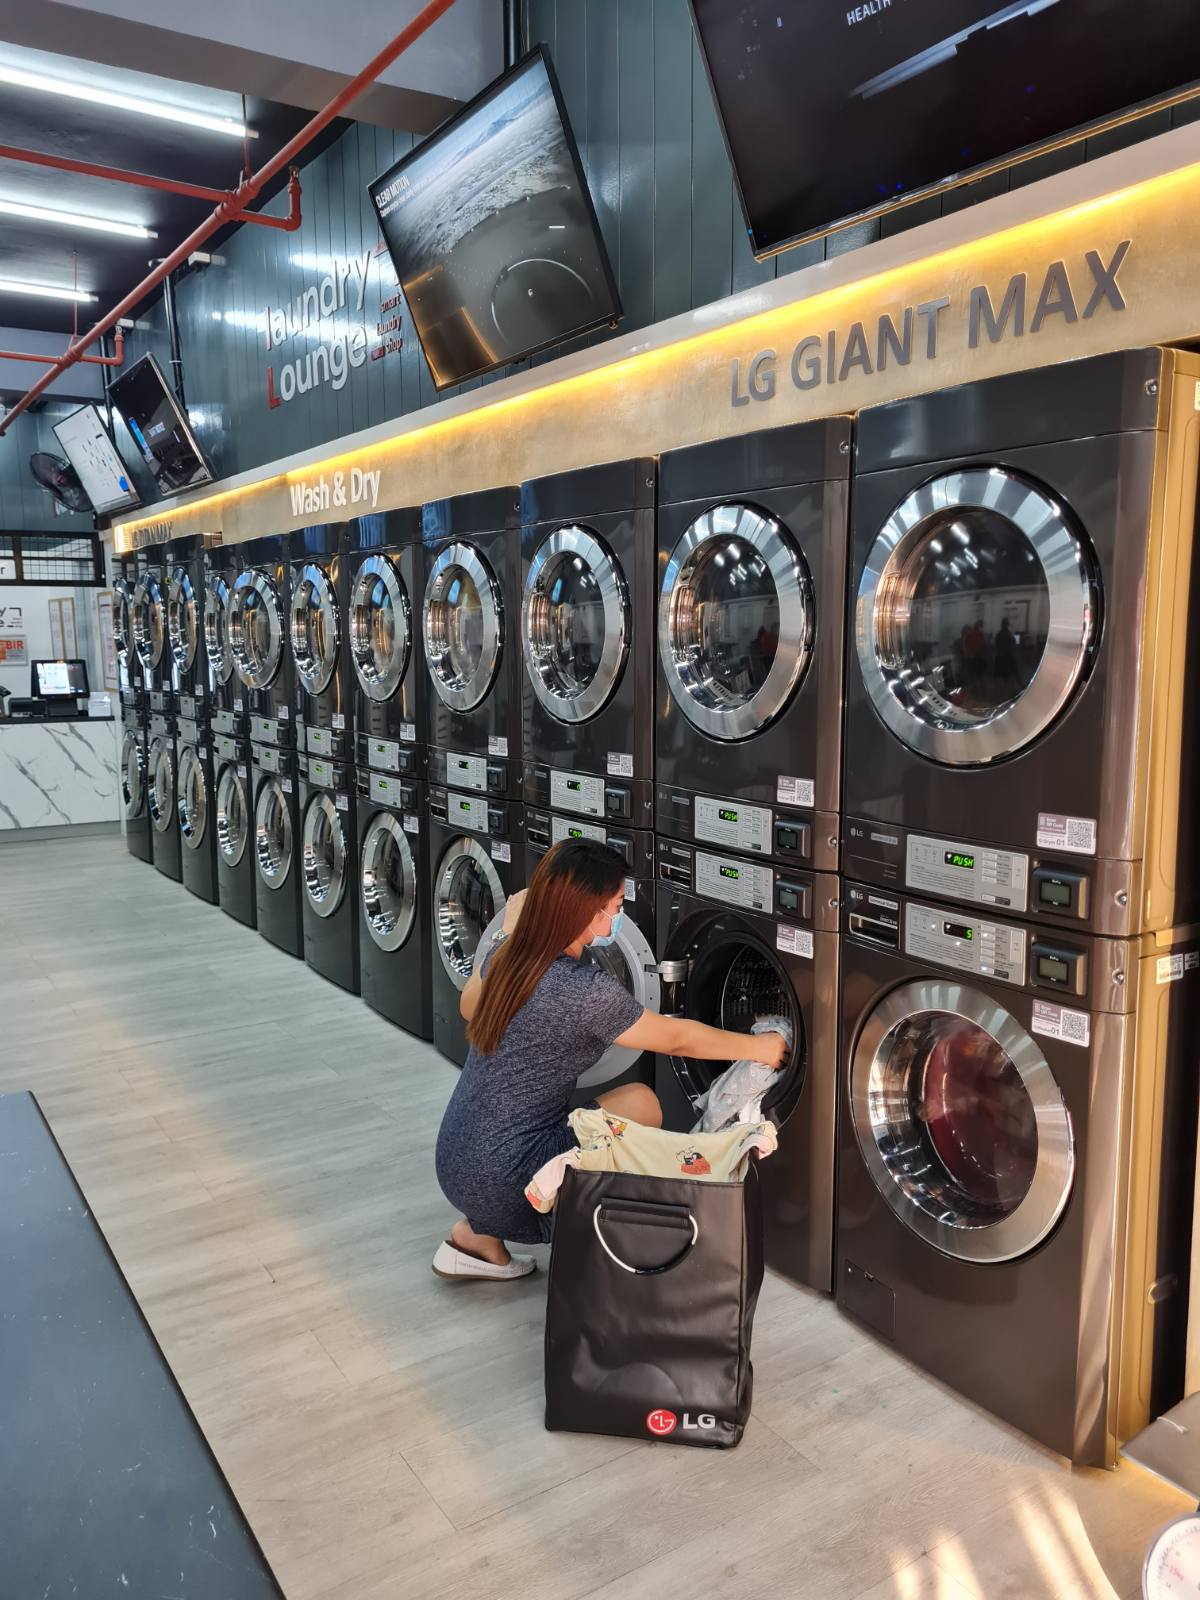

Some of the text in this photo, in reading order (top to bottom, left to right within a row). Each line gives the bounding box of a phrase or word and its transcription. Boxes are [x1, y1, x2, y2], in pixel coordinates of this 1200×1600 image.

[375, 187, 392, 208] CLEAR
[266, 250, 371, 350] laundry
[730, 239, 1133, 407] LG GIANT MAX
[267, 325, 368, 409] Lounge
[290, 467, 381, 516] Wash & Dry
[6, 640, 24, 649] BIR
[953, 855, 974, 867] PUSH
[683, 1413, 716, 1429] LG
